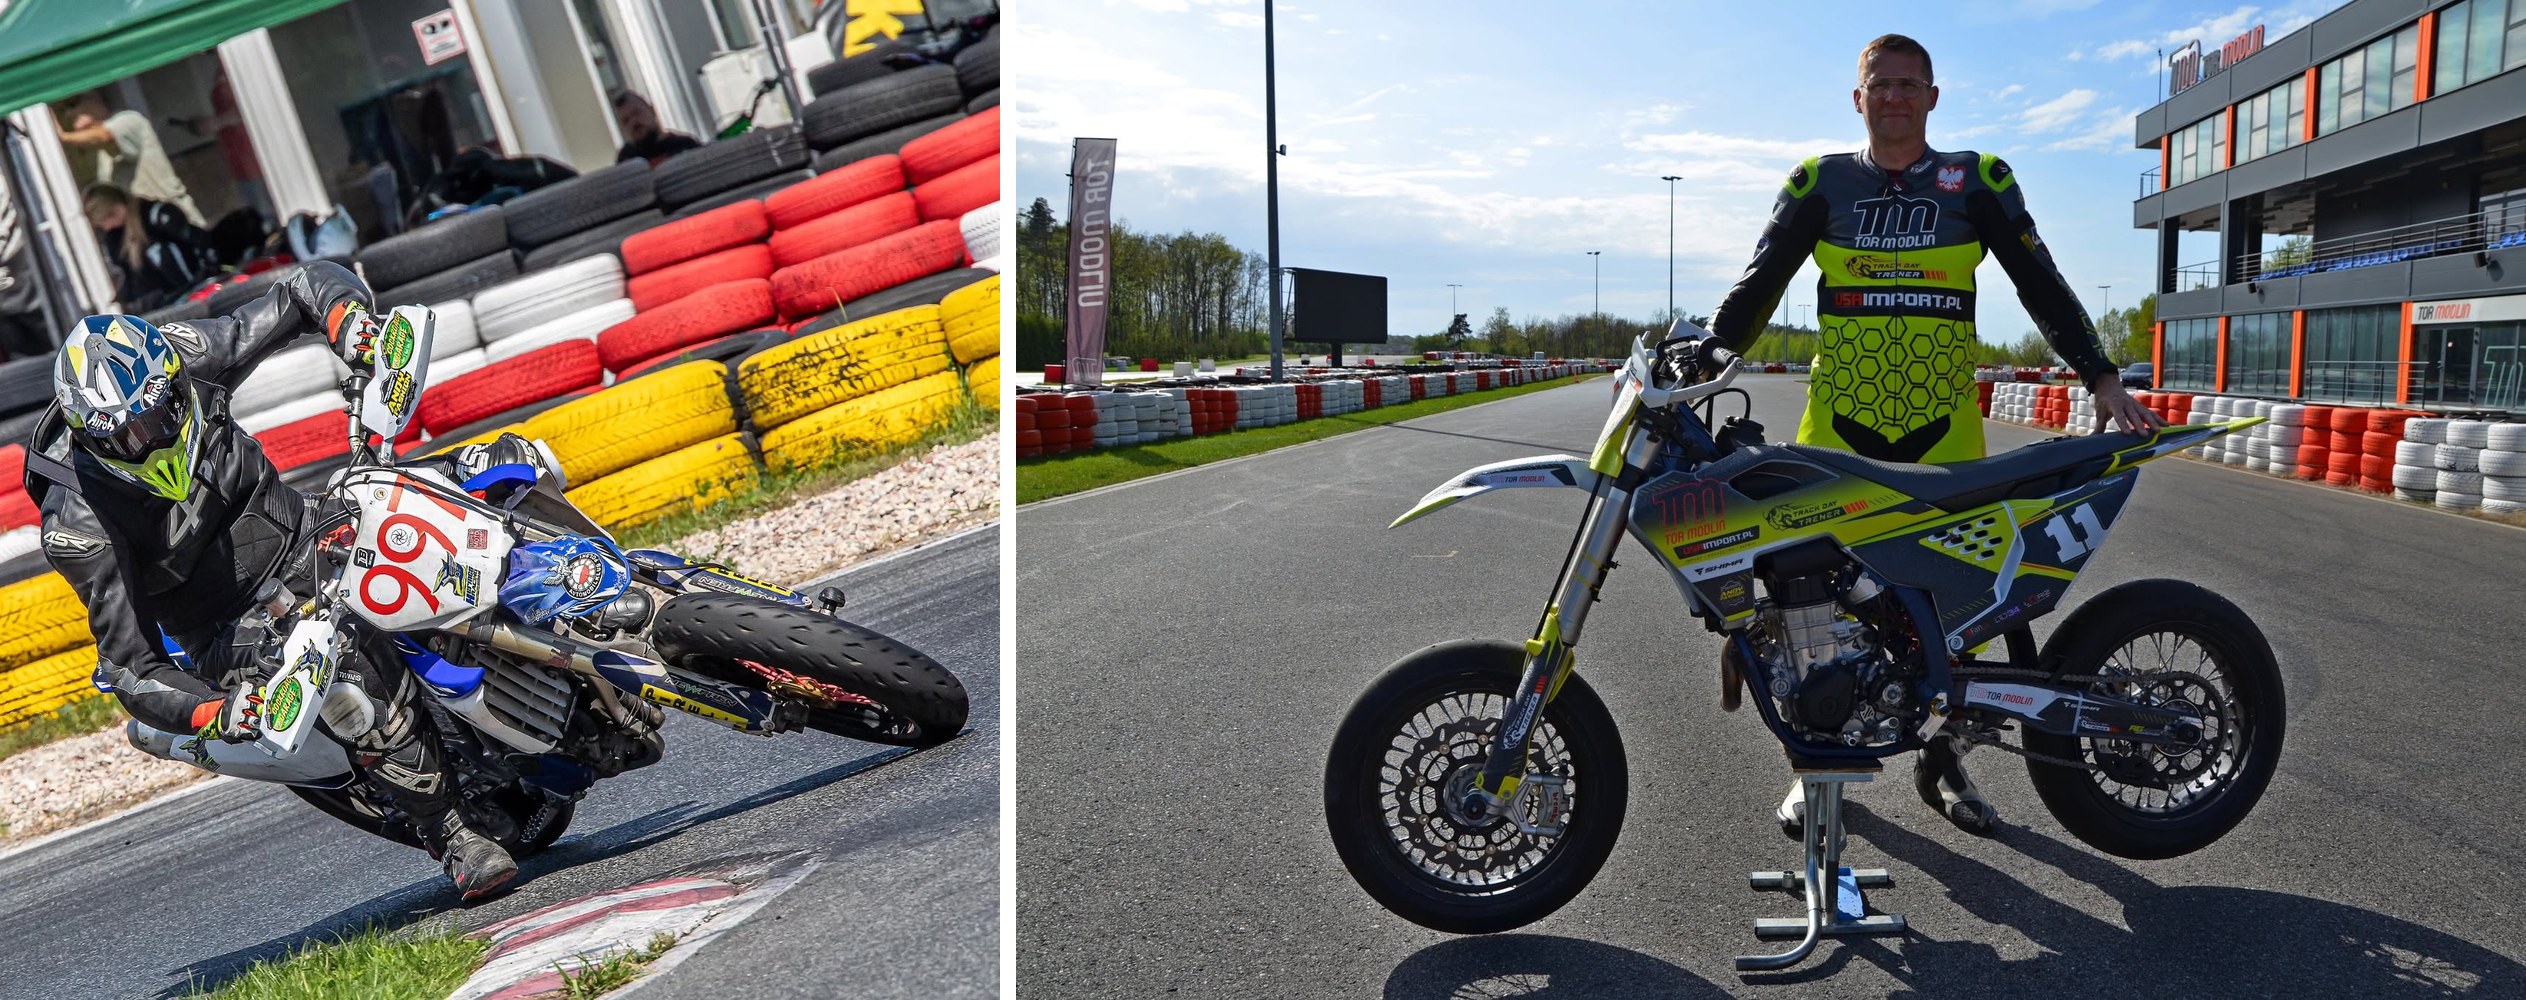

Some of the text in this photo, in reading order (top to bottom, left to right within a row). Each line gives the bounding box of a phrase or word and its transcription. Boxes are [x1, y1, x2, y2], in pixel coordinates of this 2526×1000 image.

[1855, 234, 1936, 249] TOR MODLIN
[2418, 303, 2471, 321] TOR MODLIN
[143, 376, 167, 407] Airoh
[388, 371, 405, 412] ANDY
[87, 411, 115, 432] Airoh
[1793, 500, 1838, 517] TRACK DAY
[1800, 509, 1841, 526] TRENER
[360, 473, 467, 615] 997
[1665, 520, 1726, 545] TOR MODLIN
[1705, 558, 1744, 573] SHIMA
[272, 676, 294, 715] COCKROAC
[1987, 691, 2001, 700] TOR
[2002, 695, 2034, 706] MODLIN
[1514, 694, 1532, 730] TRACK DAY
[1522, 695, 1538, 730] TRENER
[1549, 792, 1559, 824] brembo
